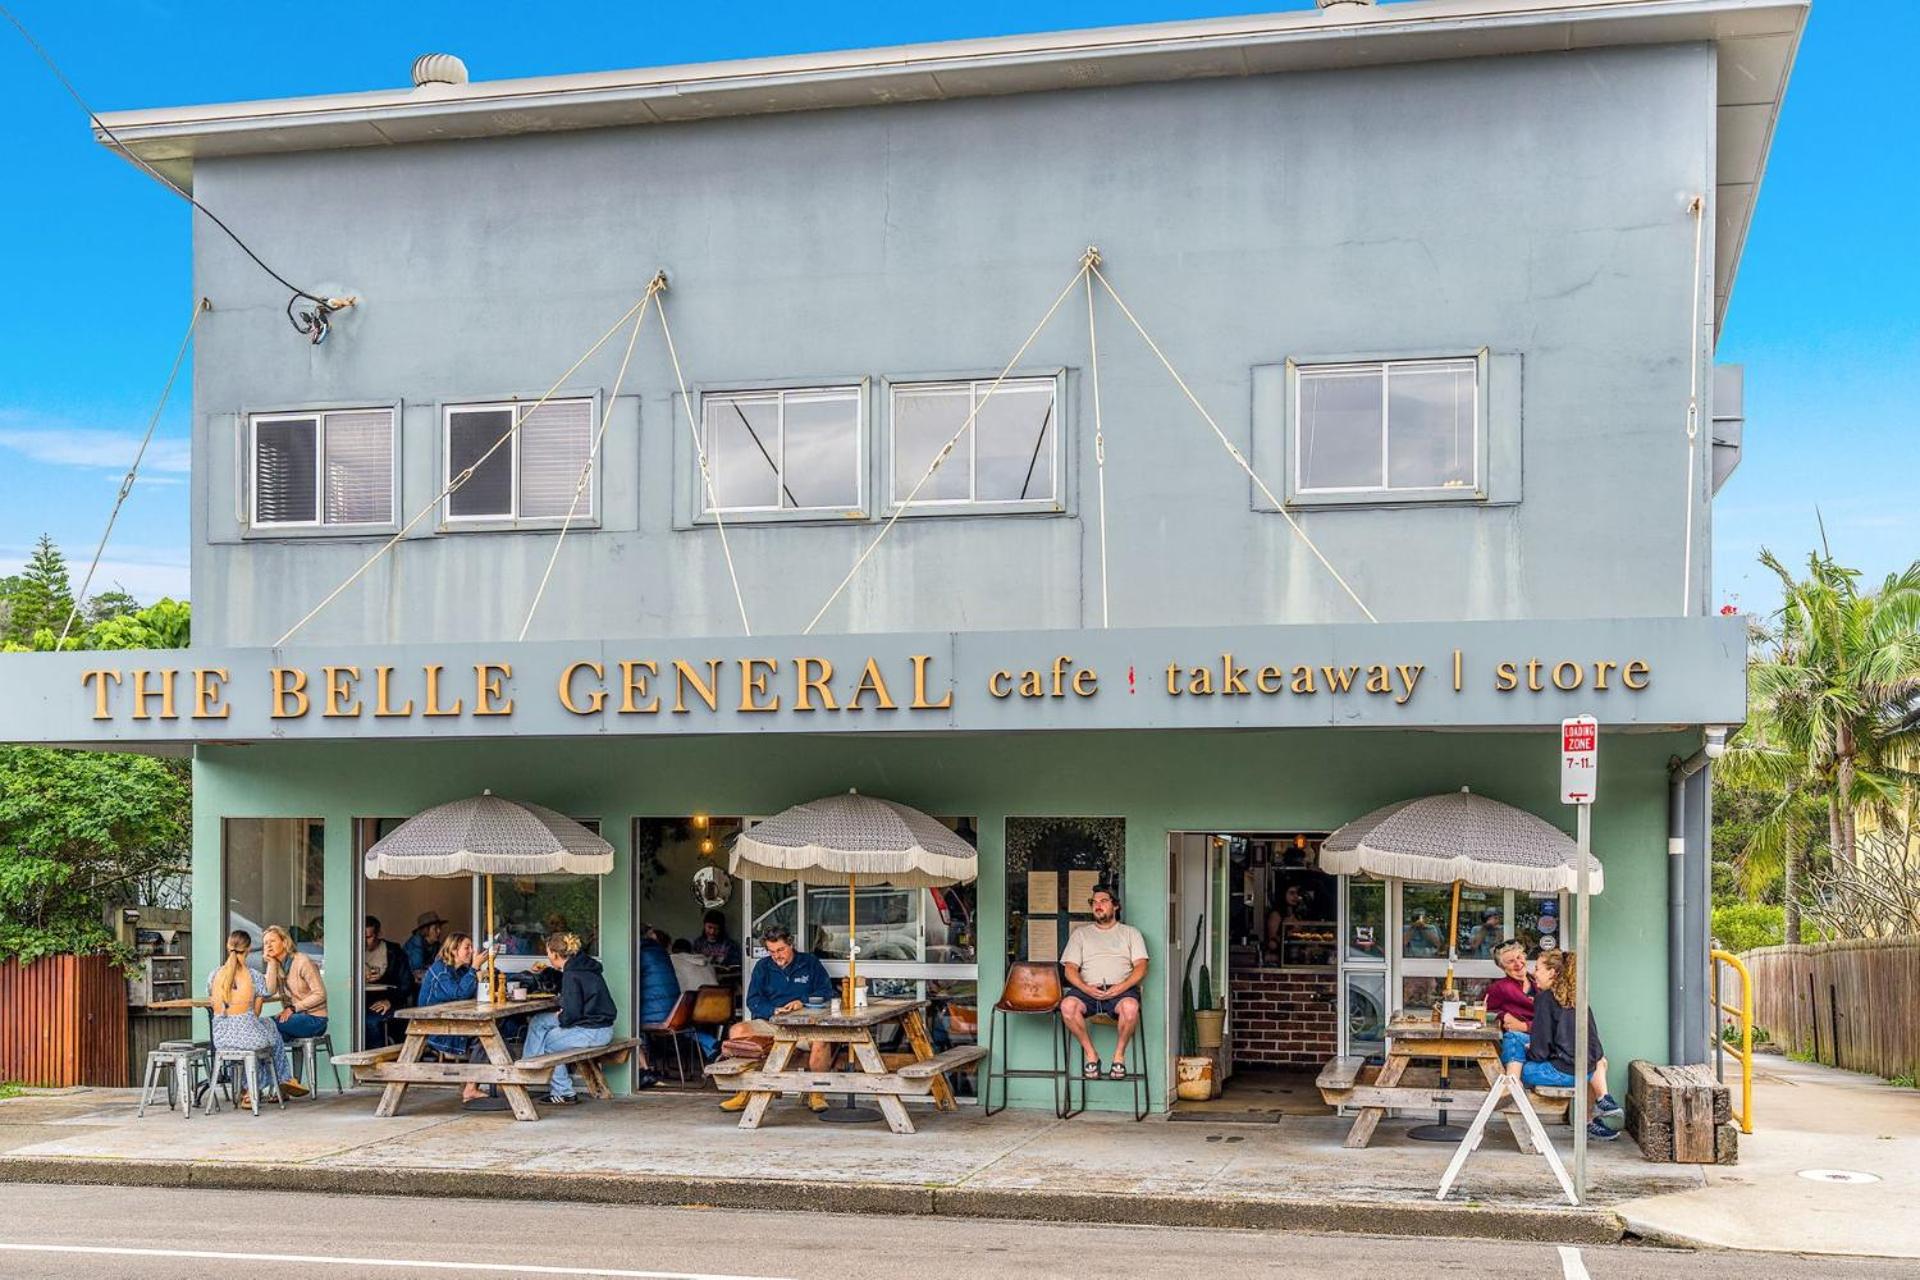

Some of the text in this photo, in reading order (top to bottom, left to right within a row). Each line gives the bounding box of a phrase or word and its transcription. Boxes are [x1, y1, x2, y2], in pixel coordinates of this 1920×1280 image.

[82, 667, 230, 719] THE
[270, 662, 515, 718] BELLE
[557, 654, 955, 715] GENERAL
[988, 655, 1099, 698] cafe
[1165, 652, 1425, 704] takeaway
[1496, 657, 1652, 692] store
[1565, 726, 1594, 737] LOADING
[1568, 738, 1592, 750] ZONE
